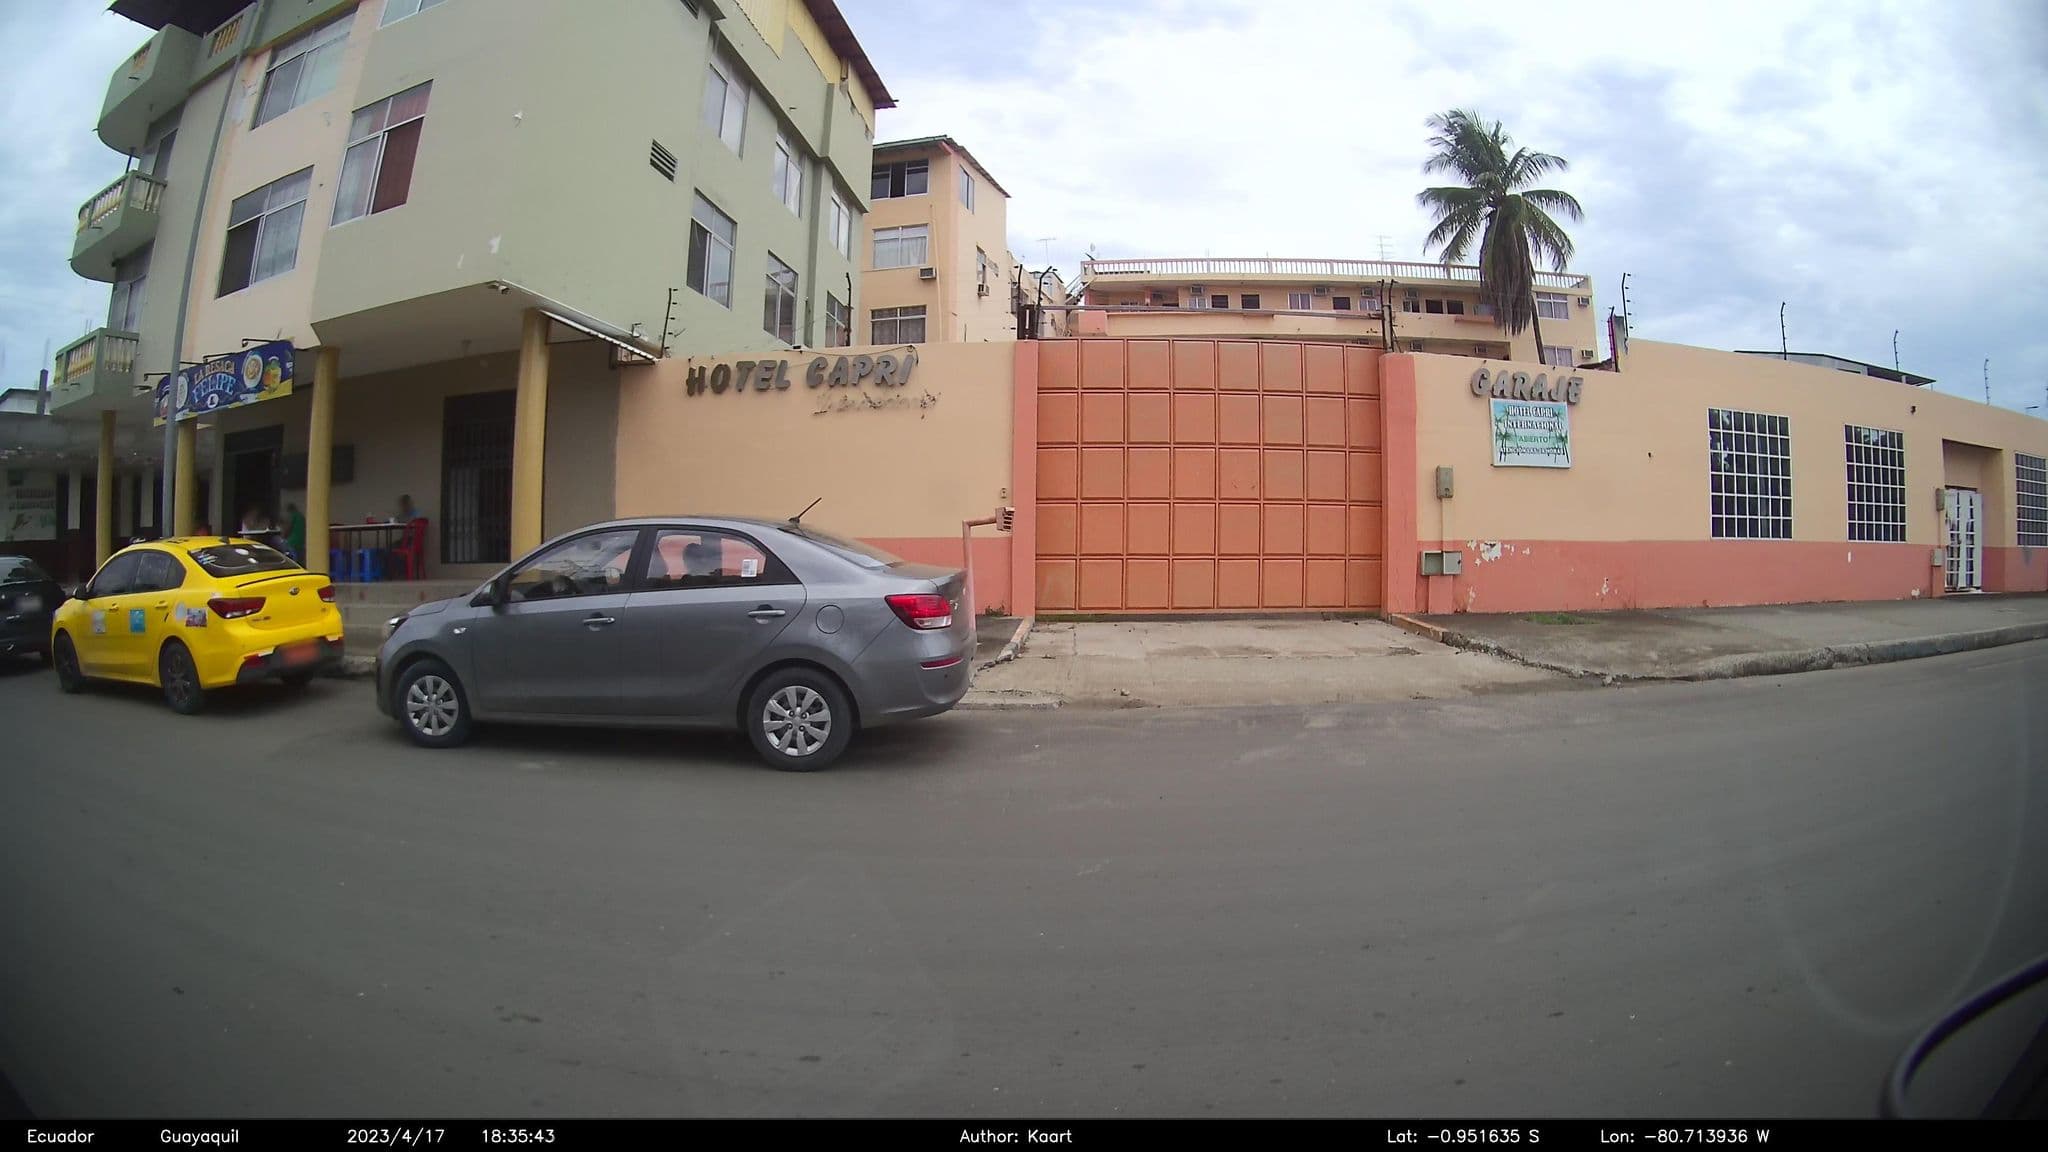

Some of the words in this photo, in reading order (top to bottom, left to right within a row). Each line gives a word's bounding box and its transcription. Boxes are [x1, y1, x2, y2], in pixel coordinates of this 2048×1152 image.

[194, 369, 204, 385] LA
[205, 360, 235, 376] RESACA
[686, 359, 791, 397] HOTEL
[806, 354, 917, 389] CAPRI
[1470, 367, 1584, 405] GARAJE
[192, 373, 237, 403] FELIPE
[1508, 405, 1531, 417] HOTEL
